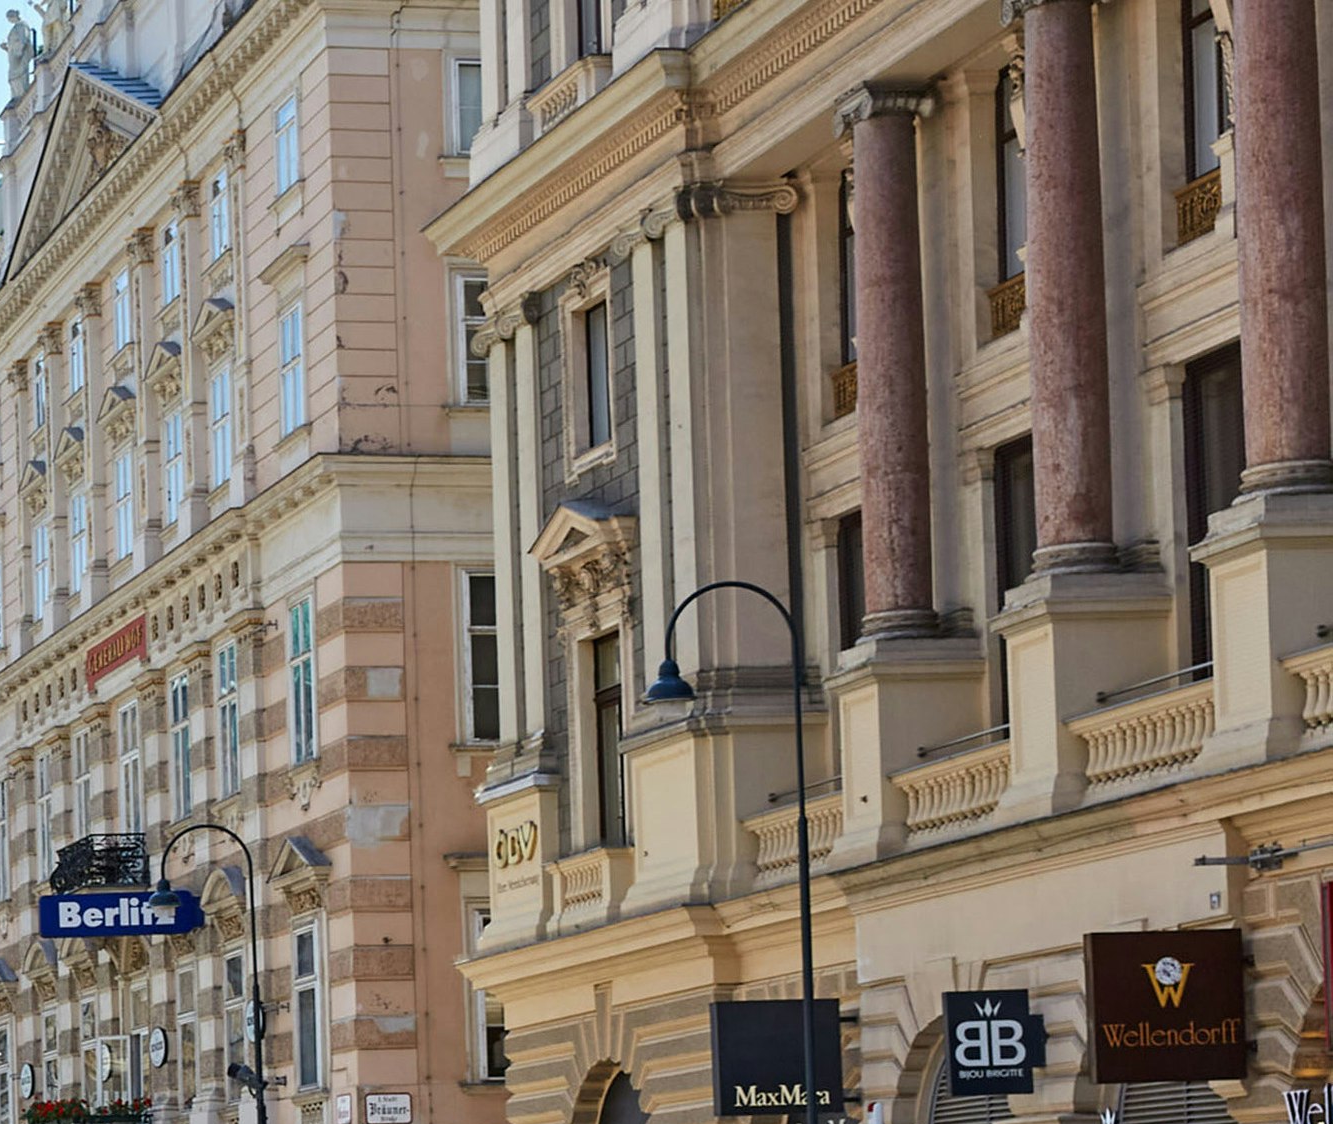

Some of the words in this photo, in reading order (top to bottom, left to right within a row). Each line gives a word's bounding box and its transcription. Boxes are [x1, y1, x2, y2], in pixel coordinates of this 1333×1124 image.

[1102, 1018, 1241, 1048] Wellendorff
[958, 1070, 984, 1080] BIJOU
[986, 1068, 1024, 1079] BRIGITTE
